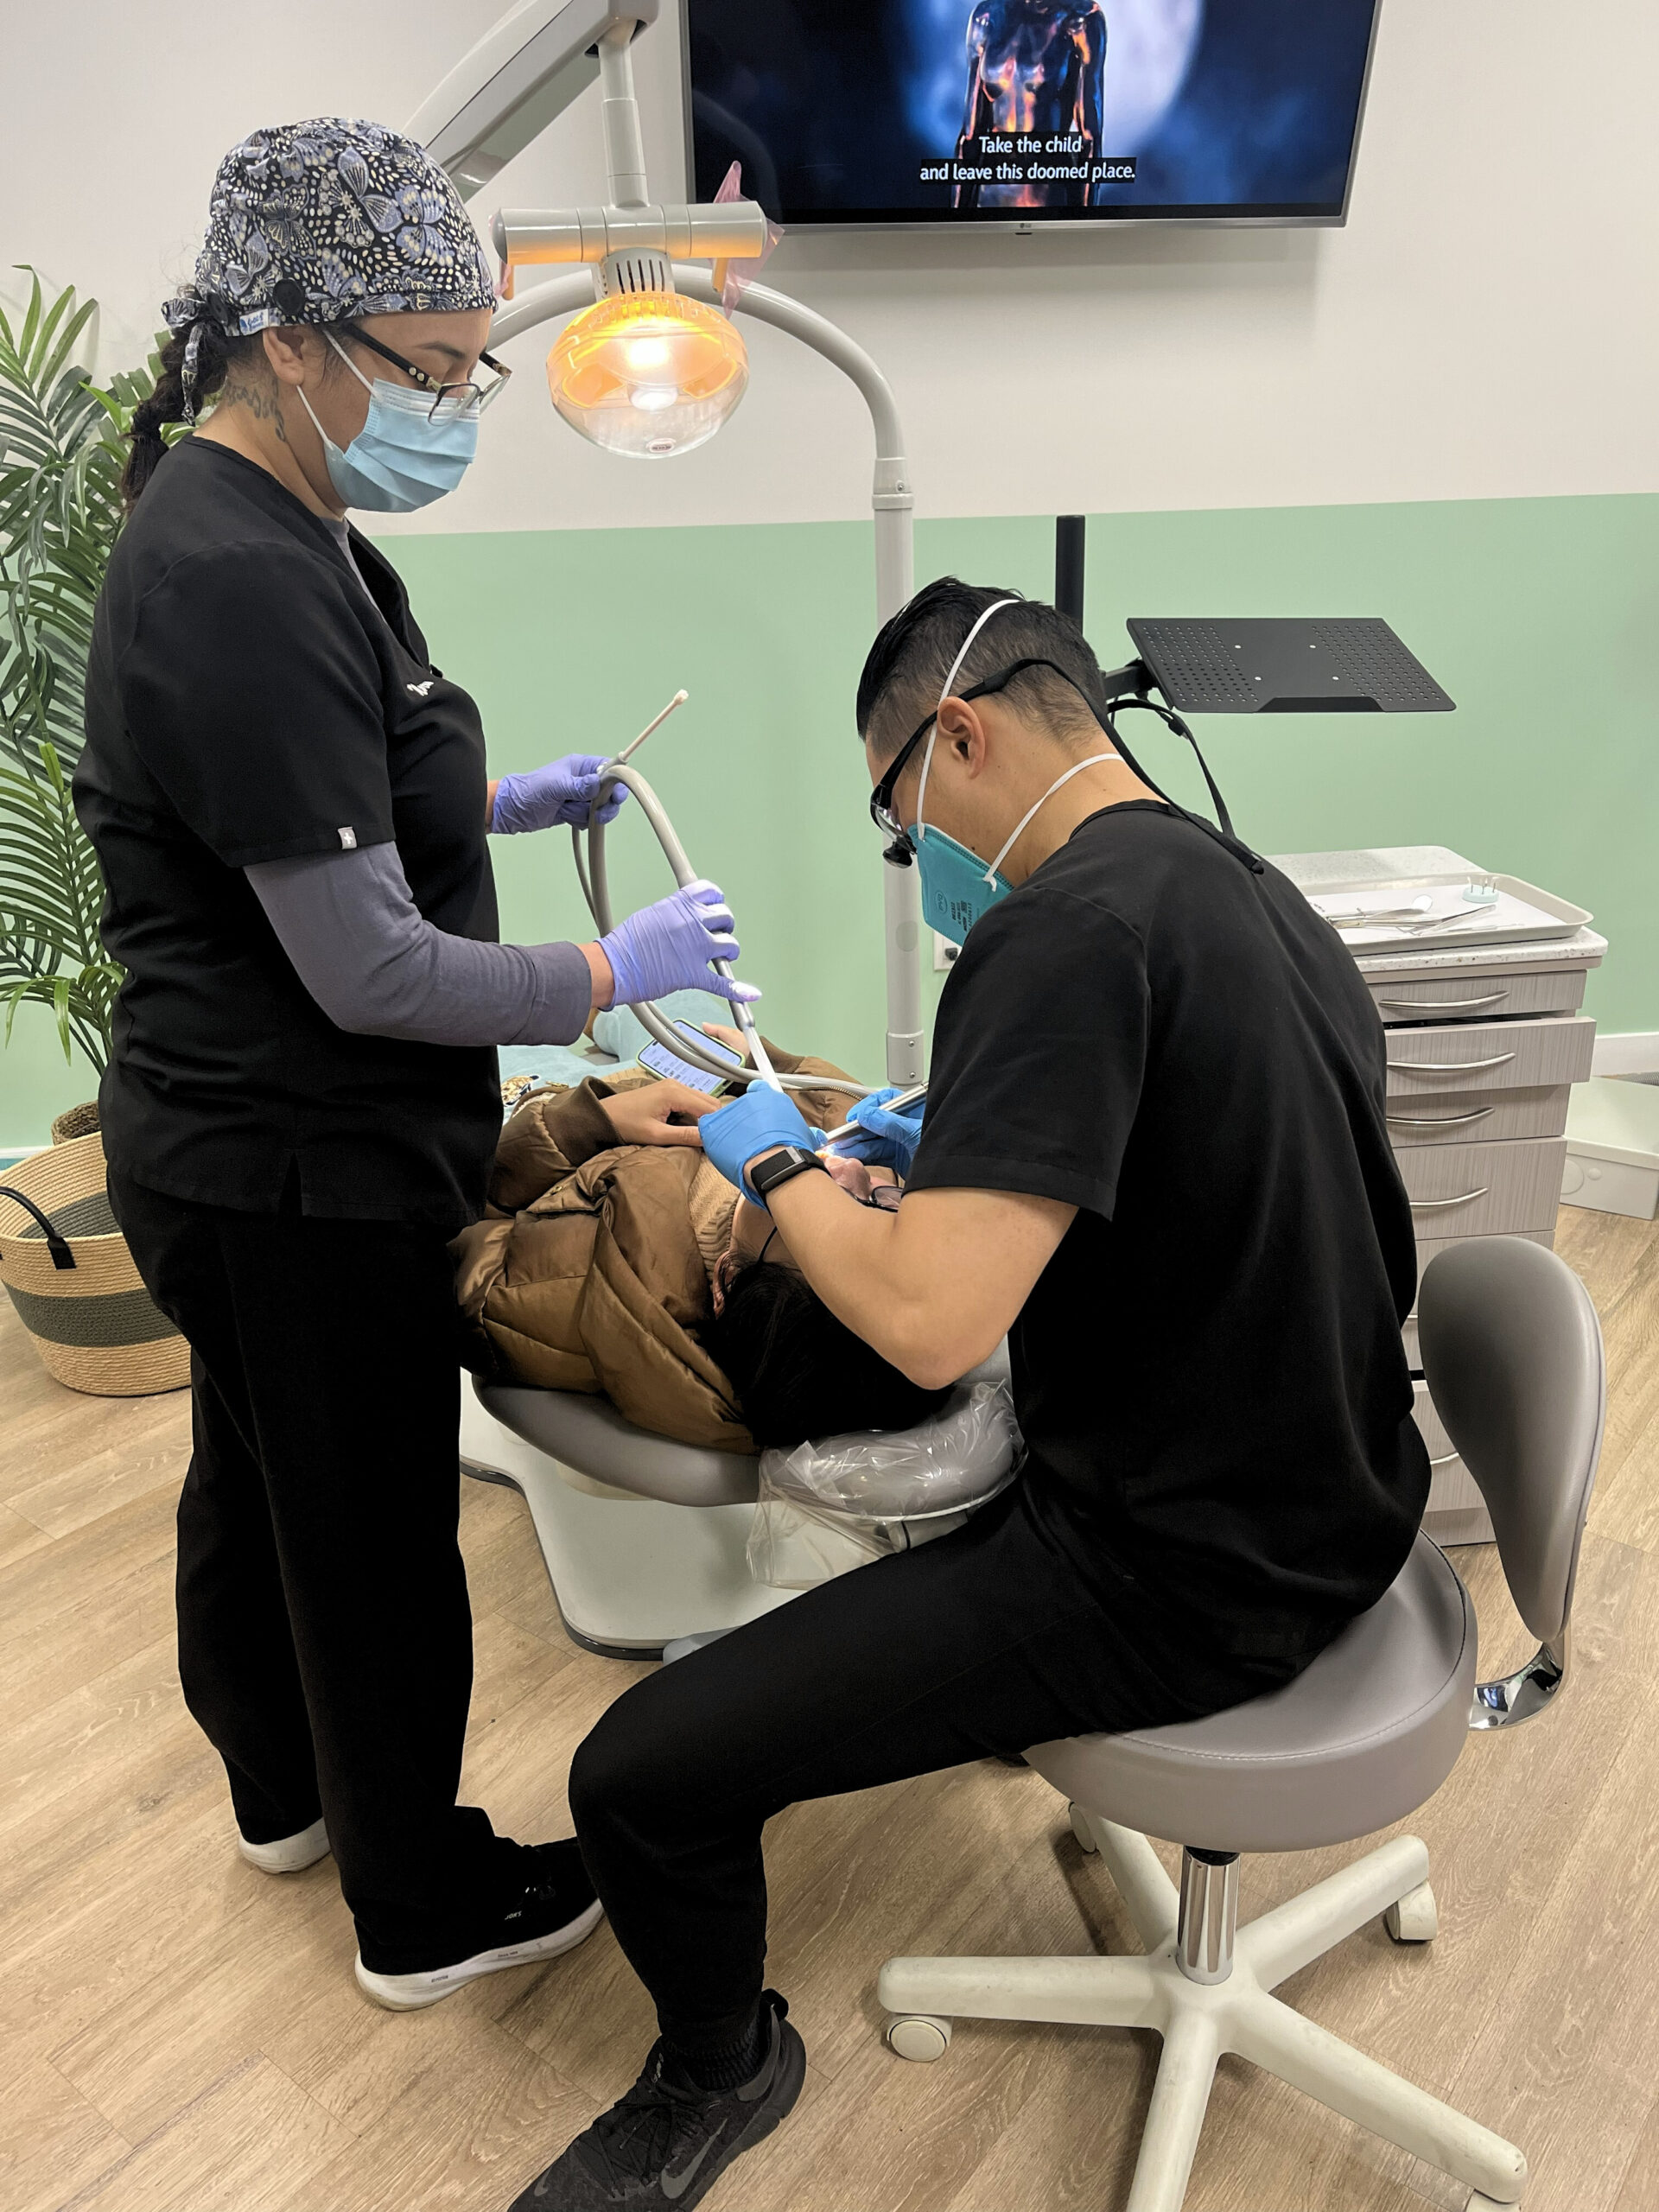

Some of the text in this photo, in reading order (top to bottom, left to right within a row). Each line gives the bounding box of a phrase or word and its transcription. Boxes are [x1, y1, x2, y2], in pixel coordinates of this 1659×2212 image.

[979, 135, 1082, 153] Take the child
[920, 162, 1135, 183] and leave this doomed place.
